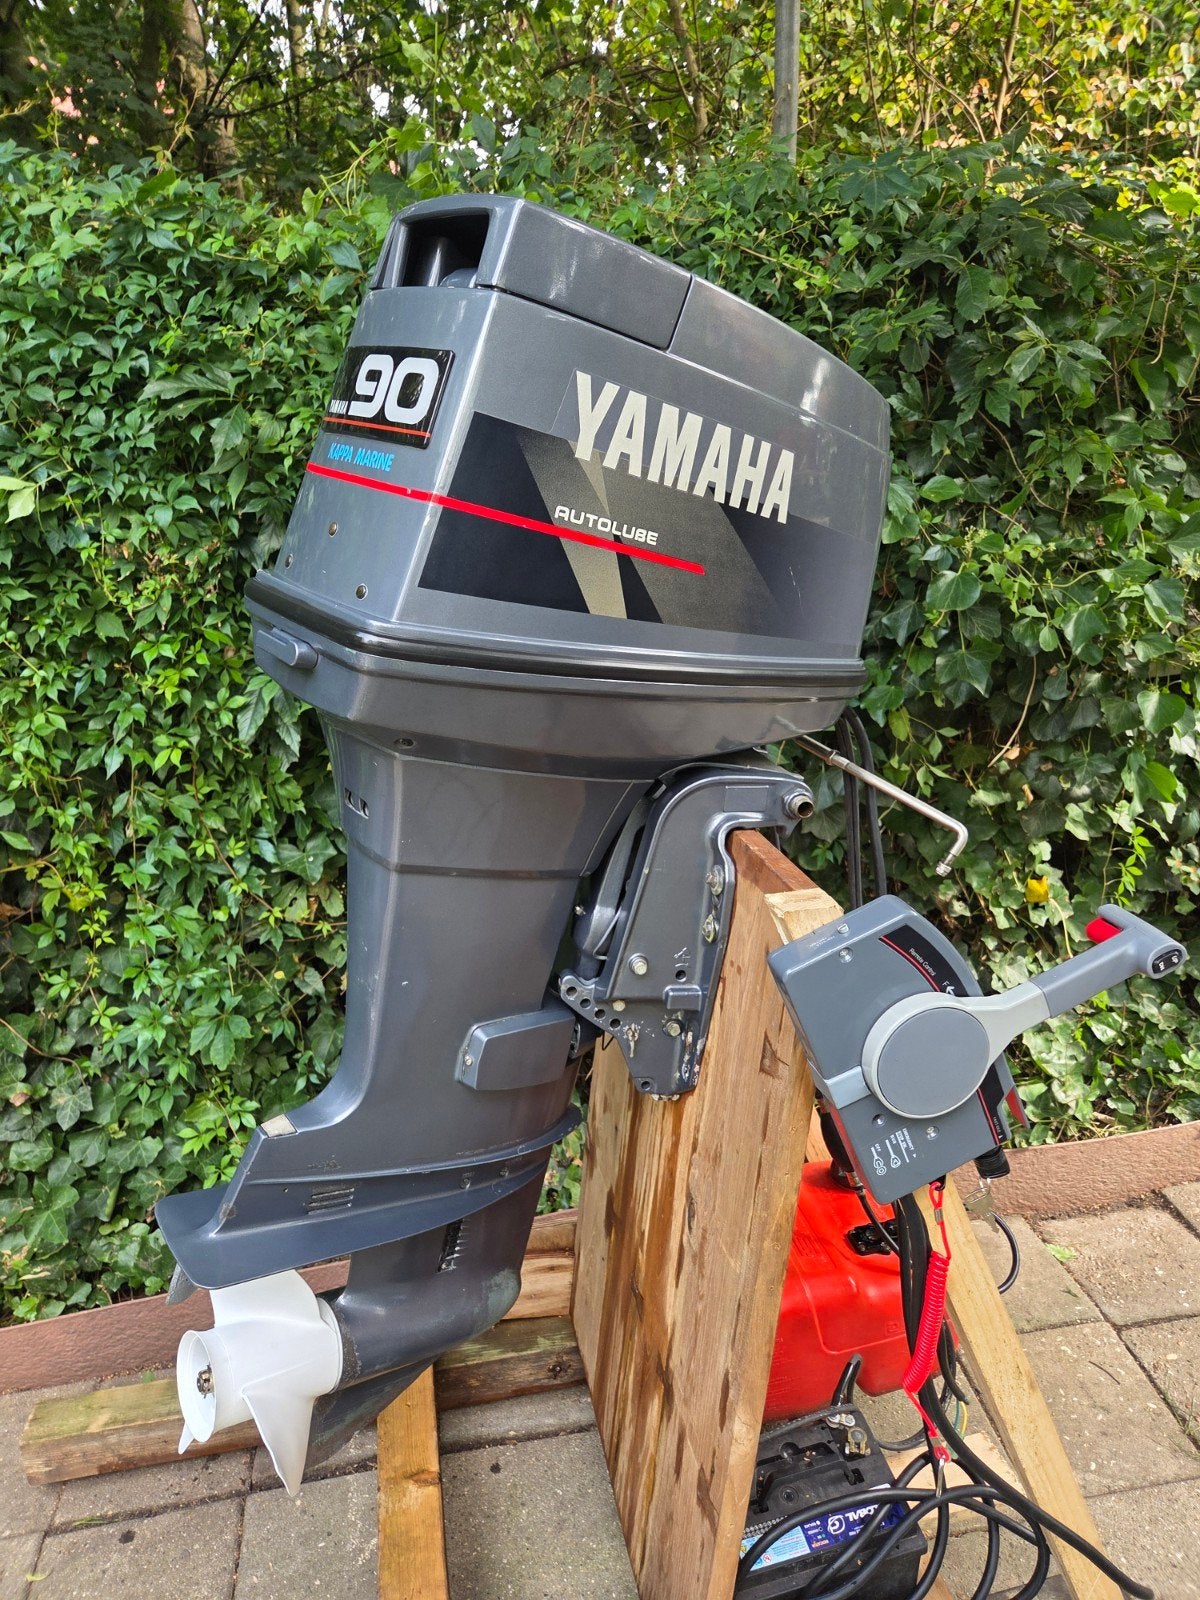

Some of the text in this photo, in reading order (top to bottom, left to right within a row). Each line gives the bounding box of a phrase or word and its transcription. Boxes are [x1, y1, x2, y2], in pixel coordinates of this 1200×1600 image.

[347, 353, 440, 425] 90
[328, 443, 395, 471] KAPPA MARINE
[575, 370, 795, 525] YAMAHA
[554, 505, 659, 546] AUTOLUBE
